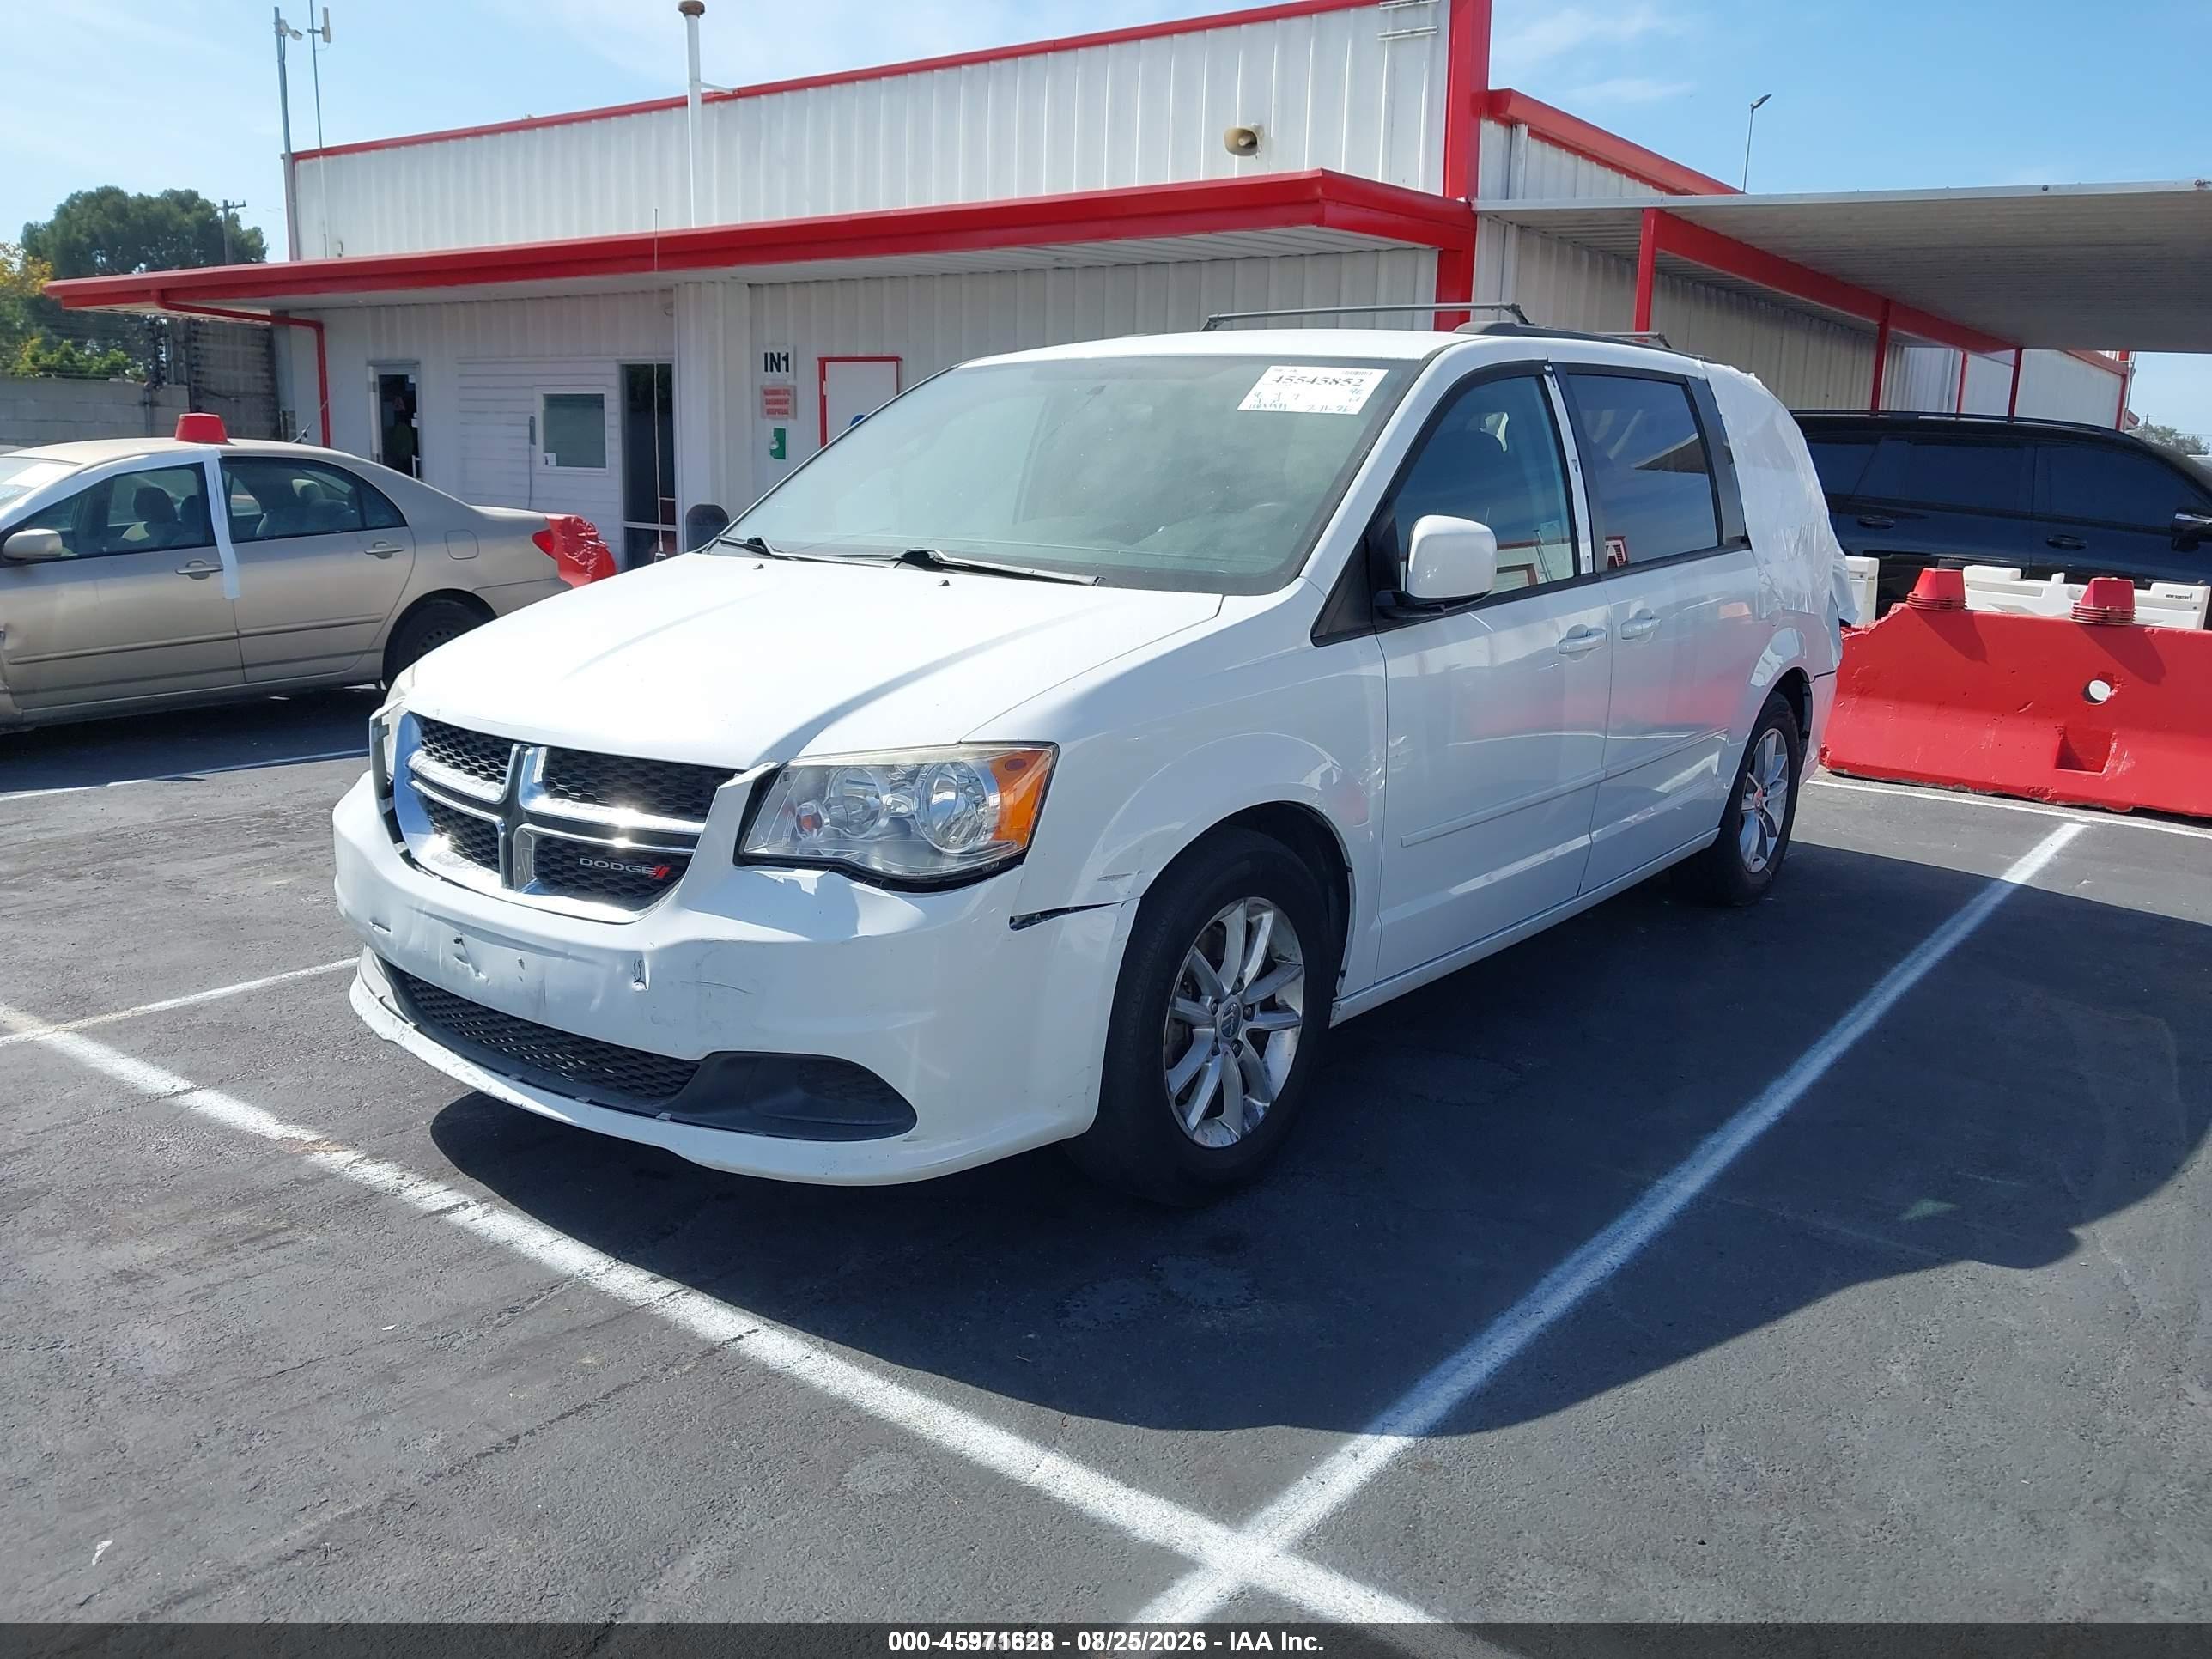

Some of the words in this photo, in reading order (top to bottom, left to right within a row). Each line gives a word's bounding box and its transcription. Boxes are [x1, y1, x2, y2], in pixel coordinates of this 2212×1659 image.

[763, 352, 790, 373] IN1
[1272, 374, 1364, 386] 45545852
[579, 857, 657, 876] DODGE
